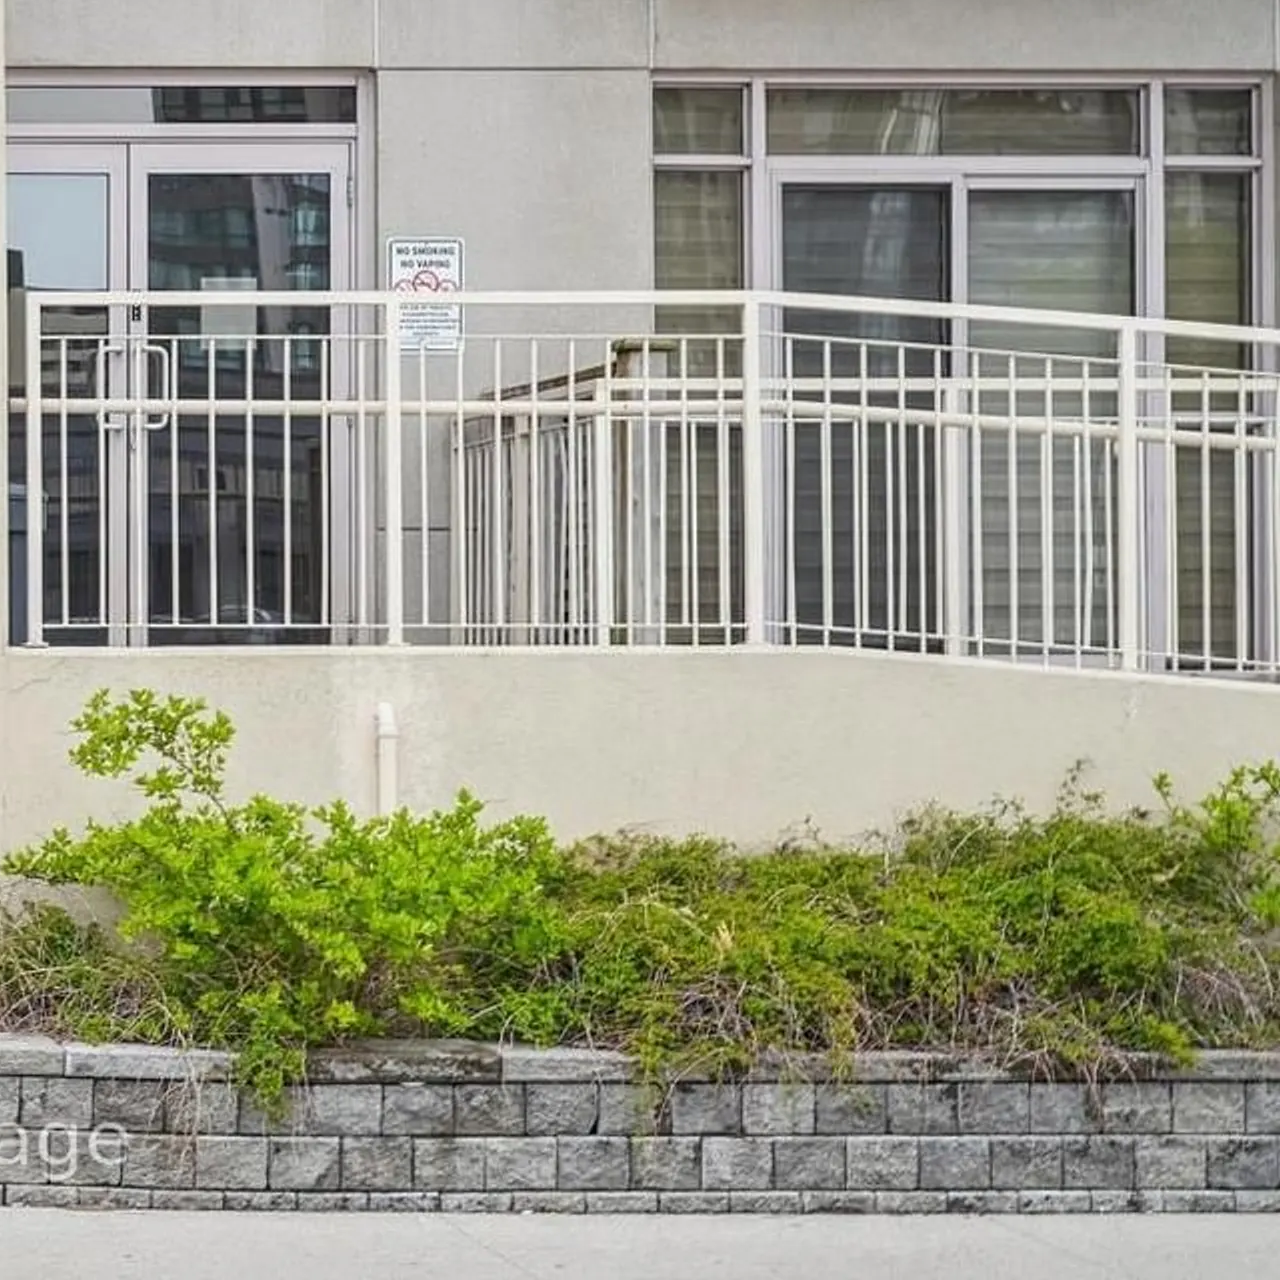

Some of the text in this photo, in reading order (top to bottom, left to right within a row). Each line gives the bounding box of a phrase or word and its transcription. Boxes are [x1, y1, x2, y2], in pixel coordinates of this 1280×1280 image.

[396, 246, 456, 255] NO SMOKING
[400, 260, 451, 269] NO VAPING
